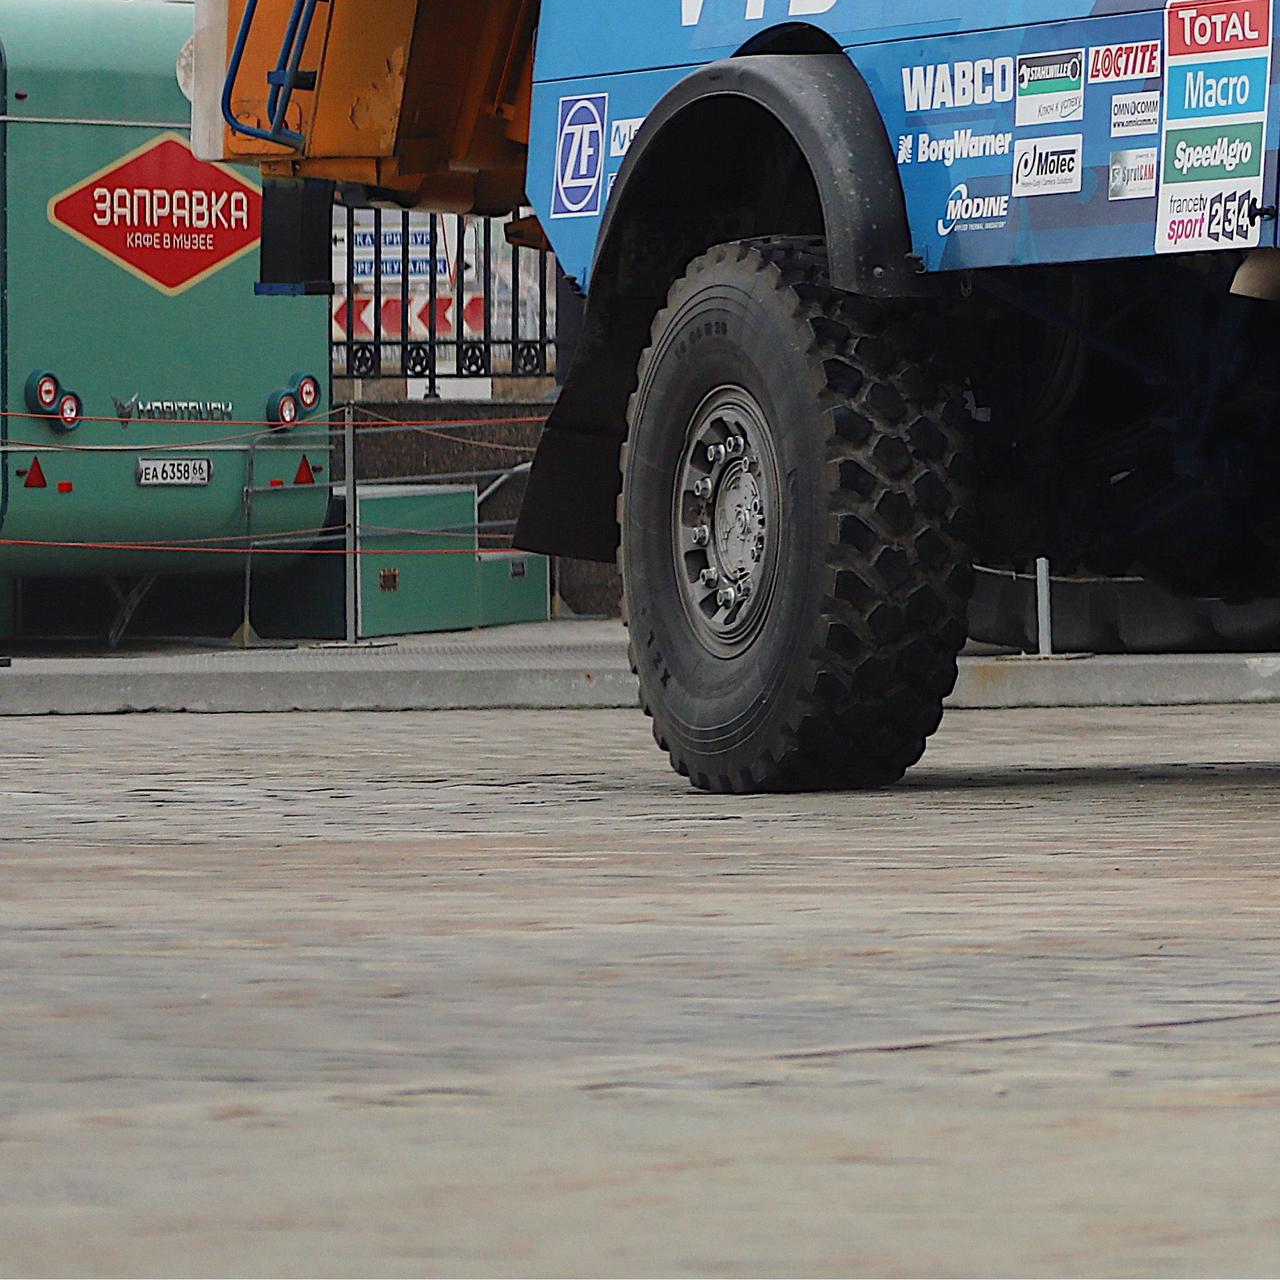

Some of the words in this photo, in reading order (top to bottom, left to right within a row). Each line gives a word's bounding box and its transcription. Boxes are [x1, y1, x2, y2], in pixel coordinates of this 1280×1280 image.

[1178, 8, 1259, 46] TOTAL
[1090, 43, 1159, 79] LOCTITE
[901, 56, 1014, 112] WABCO
[1183, 70, 1250, 110] Macro
[562, 123, 601, 189] ZF
[917, 128, 1013, 167] BorgWarner
[1173, 136, 1252, 175] SpeedAgro
[93, 187, 249, 230] ЗАПРАВКА
[945, 195, 1010, 221] MODINE
[126, 232, 161, 248] КАФЕ
[163, 233, 171, 249] В
[172, 233, 214, 251] МУЗЕЕ
[1167, 213, 1205, 245] sport
